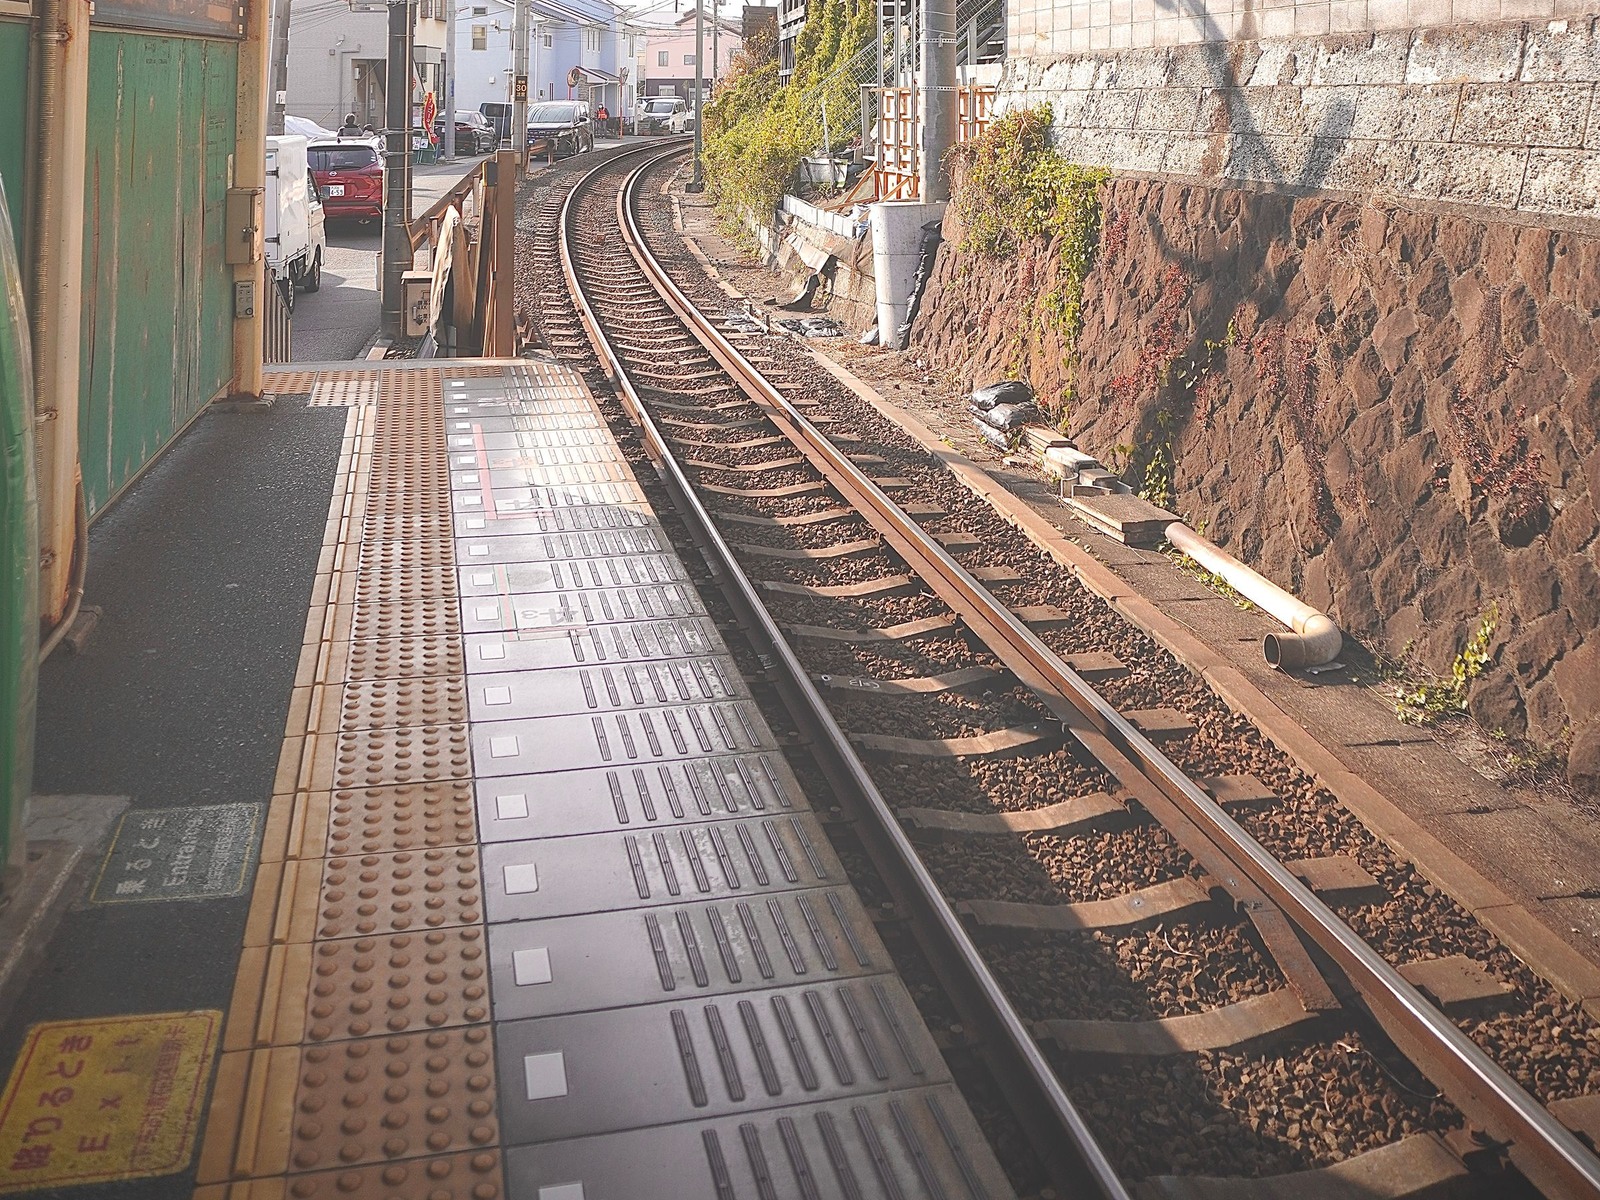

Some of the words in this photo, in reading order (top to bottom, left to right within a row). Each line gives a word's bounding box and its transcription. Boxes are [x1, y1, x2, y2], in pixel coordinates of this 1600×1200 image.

[516, 84, 527, 92] 30
[115, 817, 167, 894] 乗るとき
[162, 814, 204, 887] Entrance
[9, 1035, 93, 1170] 降りるとき
